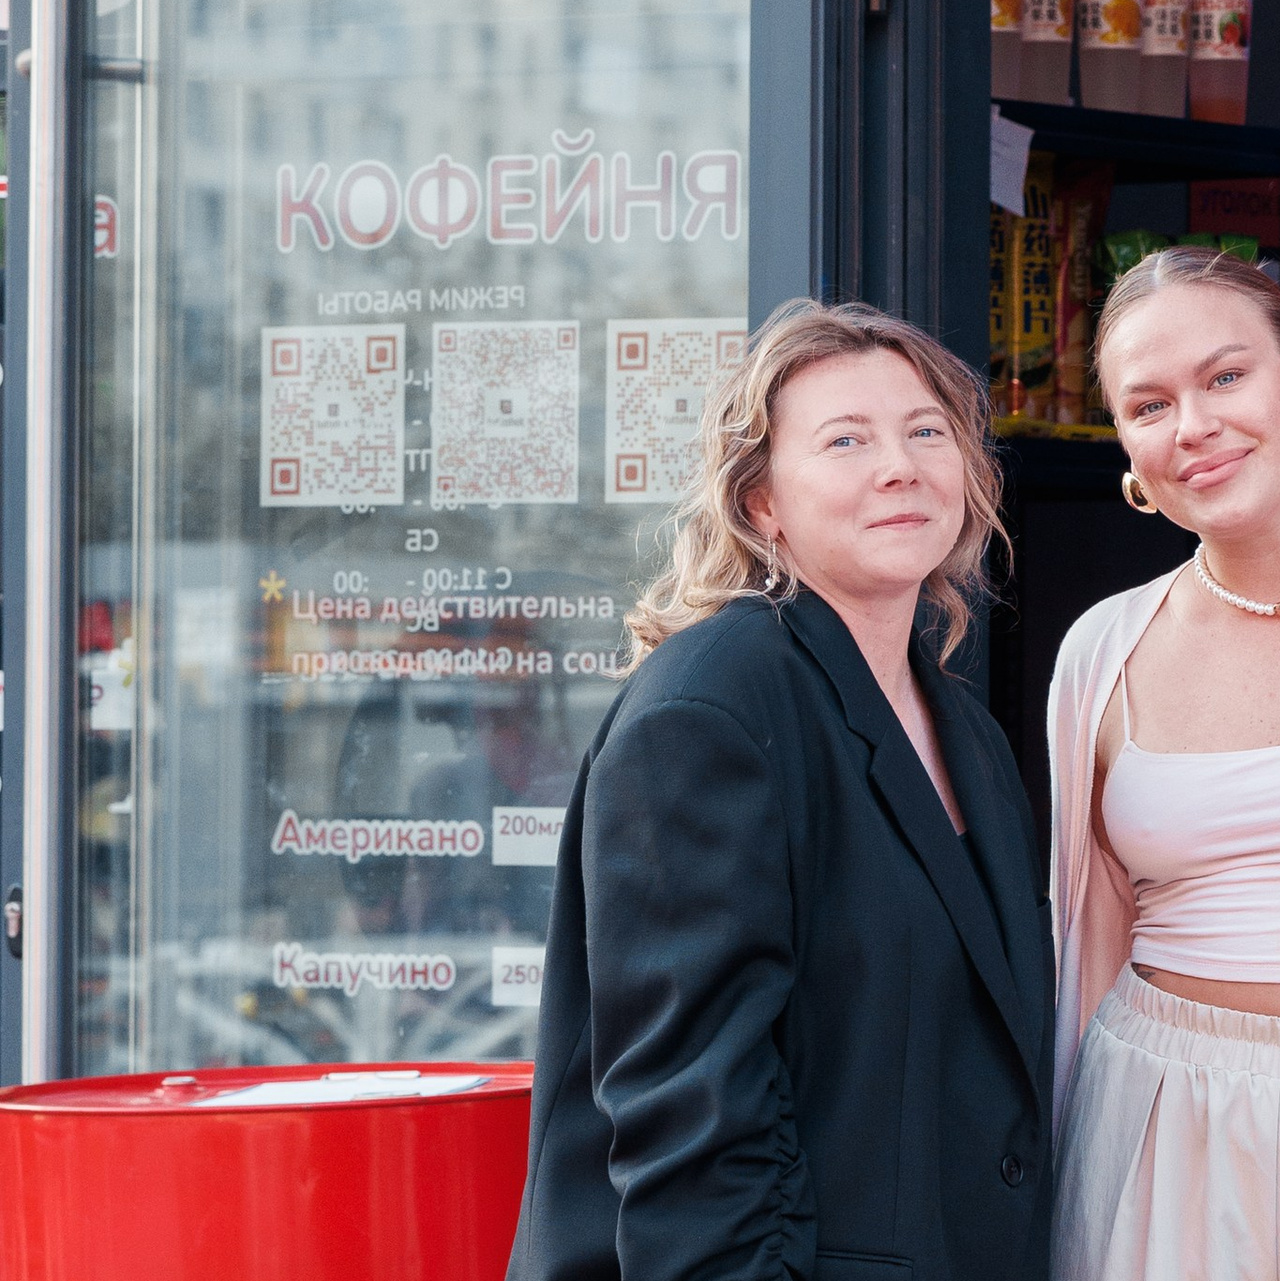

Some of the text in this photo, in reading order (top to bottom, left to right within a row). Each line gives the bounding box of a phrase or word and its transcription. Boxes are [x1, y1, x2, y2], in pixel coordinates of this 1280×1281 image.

[276, 128, 740, 253] КОФЕЙНЯ
[292, 589, 616, 625] Цена действительна
[516, 651, 554, 675] на
[274, 811, 483, 861] Американо
[275, 943, 454, 994] Капучино
